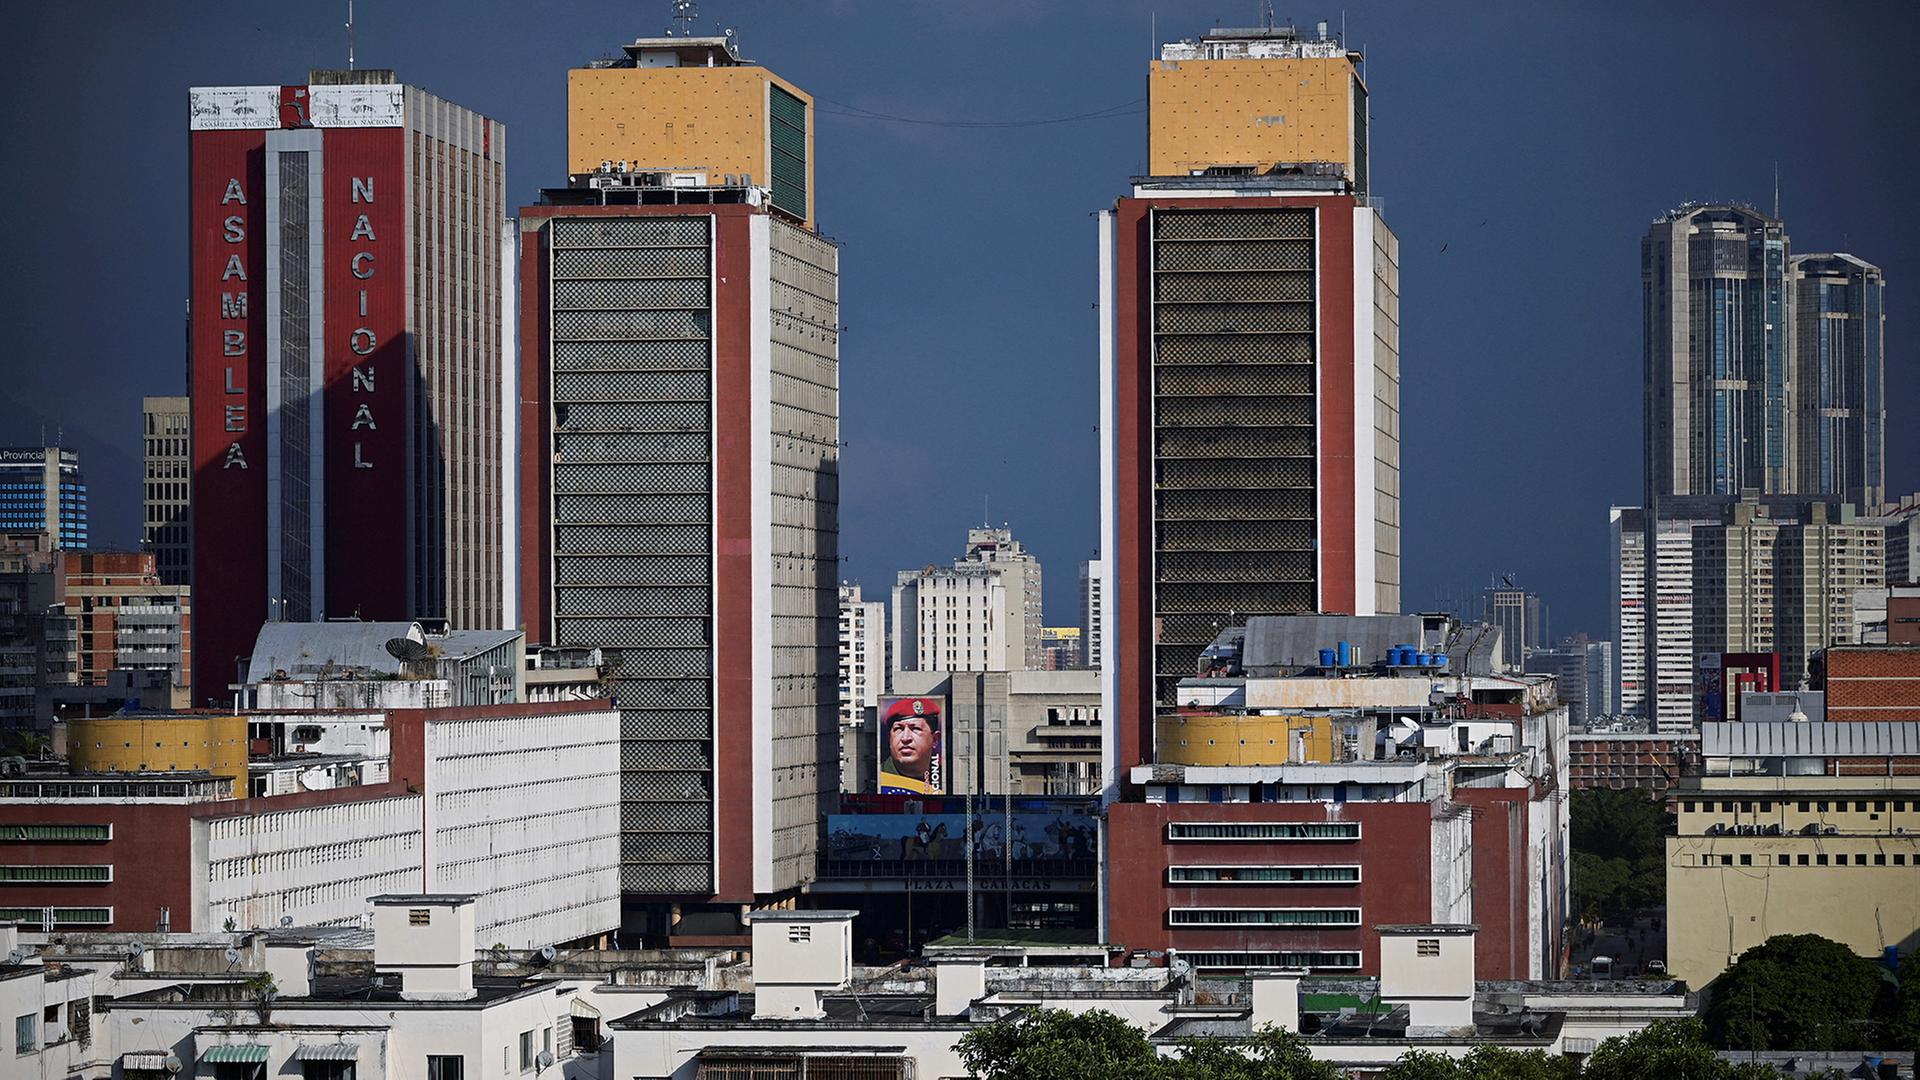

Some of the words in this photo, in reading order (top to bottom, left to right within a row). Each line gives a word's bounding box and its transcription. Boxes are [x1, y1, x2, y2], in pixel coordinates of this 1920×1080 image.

[200, 120, 239, 128] ASAMBLEA
[221, 178, 248, 469] ASAMBLEA
[351, 176, 377, 469] NACIONAL
[3, 450, 45, 460] Provincial
[904, 880, 954, 890] PLAZA
